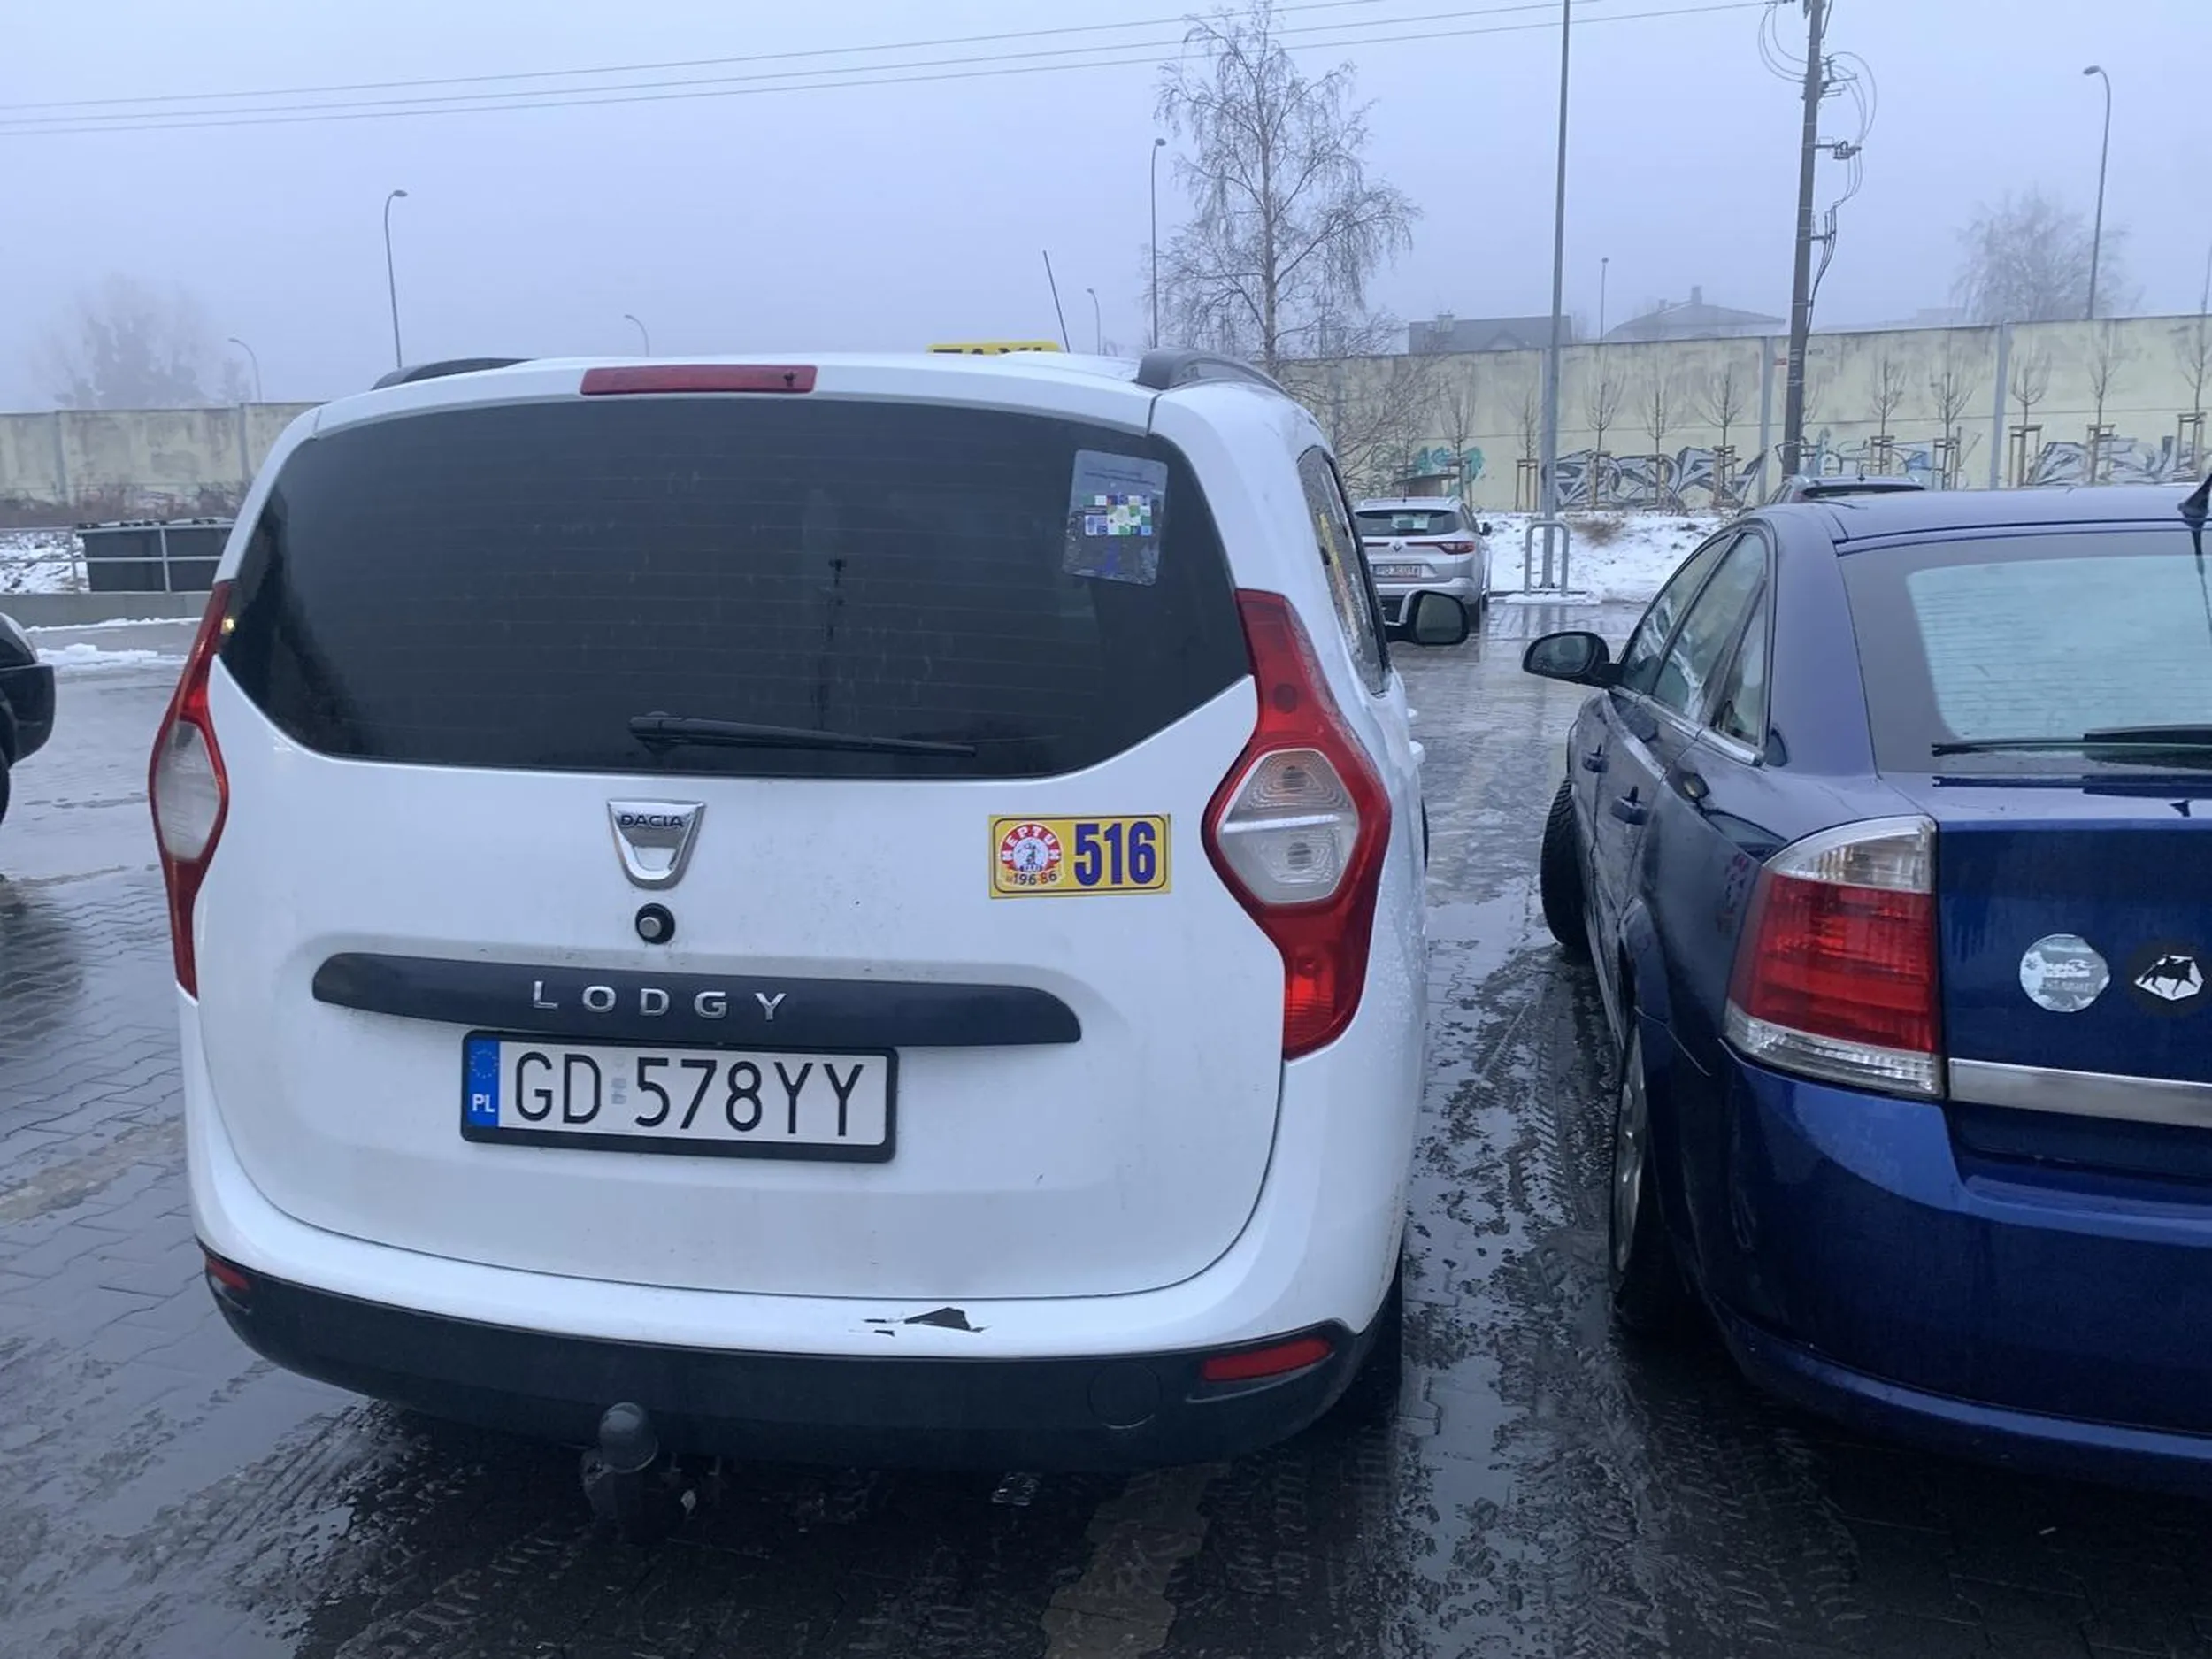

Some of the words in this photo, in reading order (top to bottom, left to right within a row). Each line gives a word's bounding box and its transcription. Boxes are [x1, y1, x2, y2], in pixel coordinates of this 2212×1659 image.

[620, 814, 685, 828] DACIA
[1073, 821, 1156, 887] 516
[533, 980, 787, 1020] LODGY
[472, 1094, 495, 1113] PL
[515, 1052, 602, 1125] GD
[634, 1056, 864, 1137] 578YY
